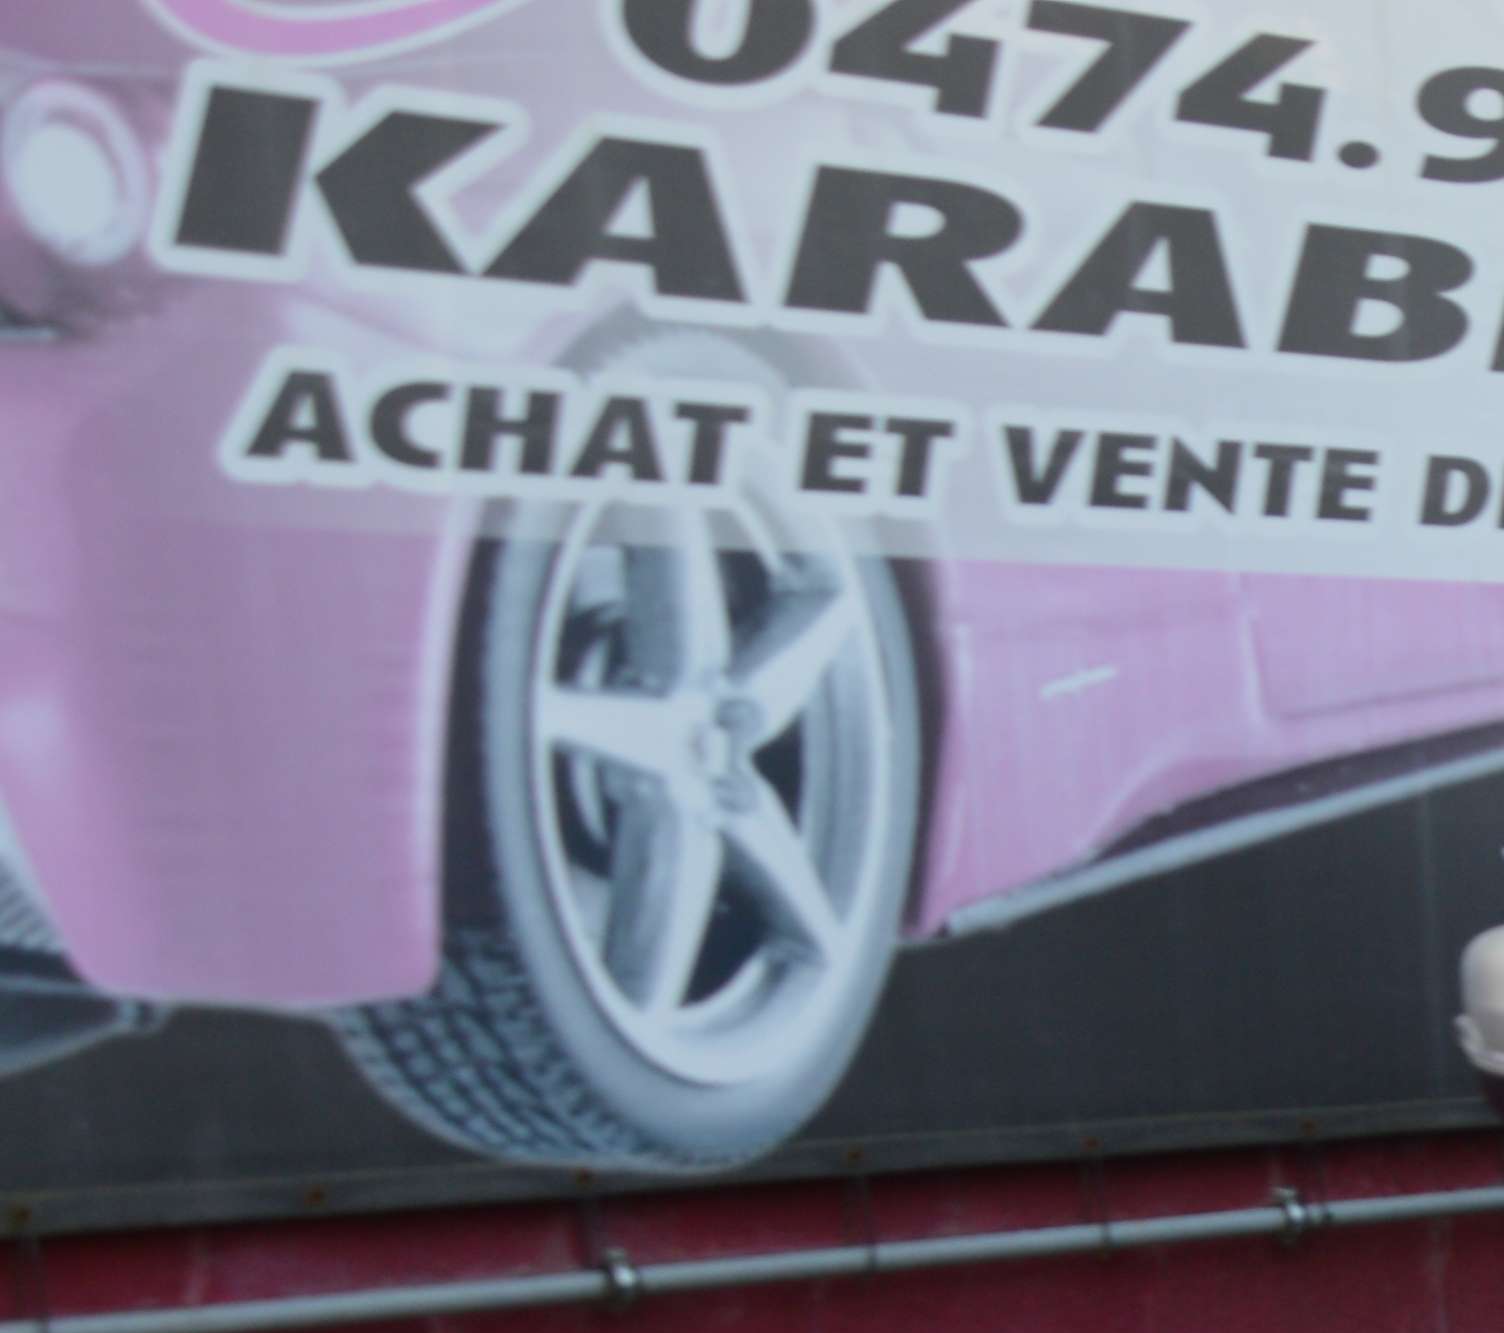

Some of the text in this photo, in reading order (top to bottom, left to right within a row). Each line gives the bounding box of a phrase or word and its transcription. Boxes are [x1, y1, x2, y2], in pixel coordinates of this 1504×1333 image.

[245, 369, 750, 486] ACHAT
[797, 410, 956, 498] ET
[1002, 423, 1382, 523] VENTE
